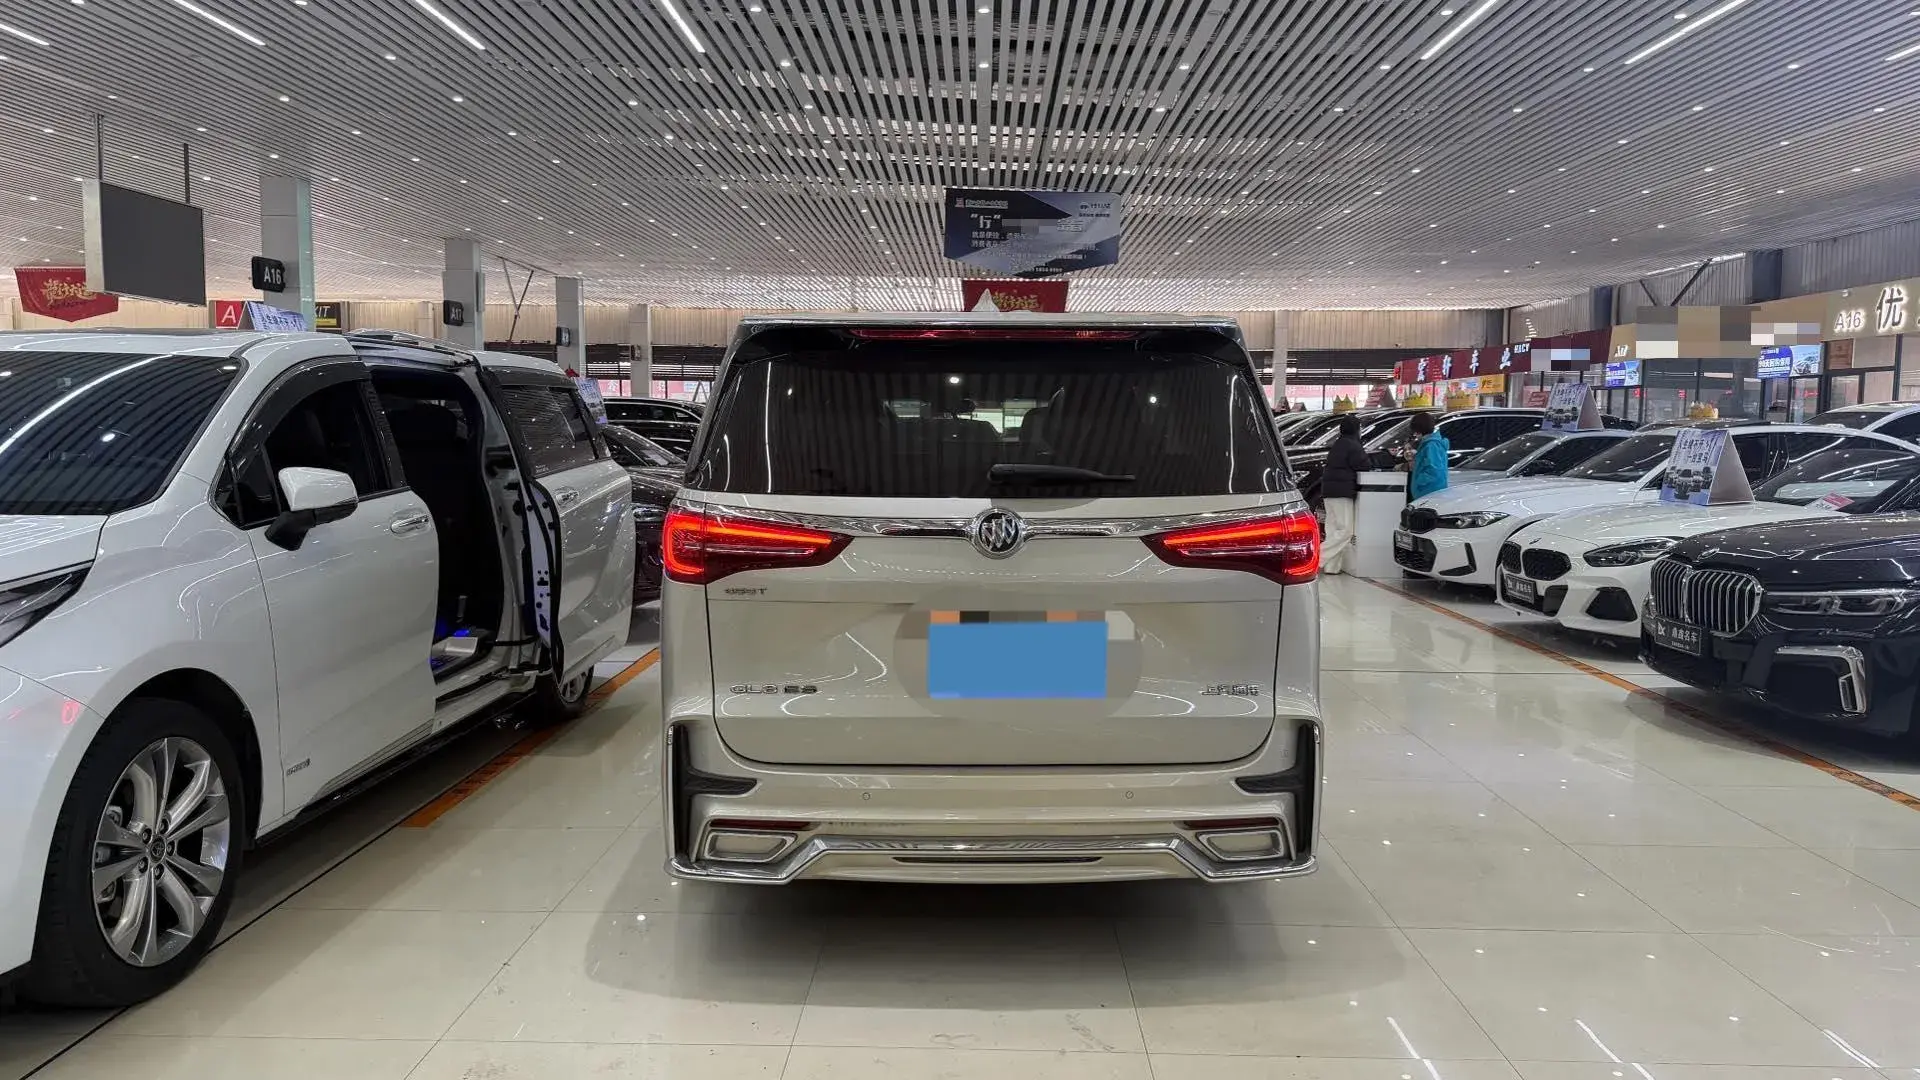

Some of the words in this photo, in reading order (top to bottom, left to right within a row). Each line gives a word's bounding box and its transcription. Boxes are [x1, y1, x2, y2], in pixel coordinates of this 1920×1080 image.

[263, 266, 282, 285] A16
[221, 305, 237, 323] A
[1834, 311, 1862, 330] A16
